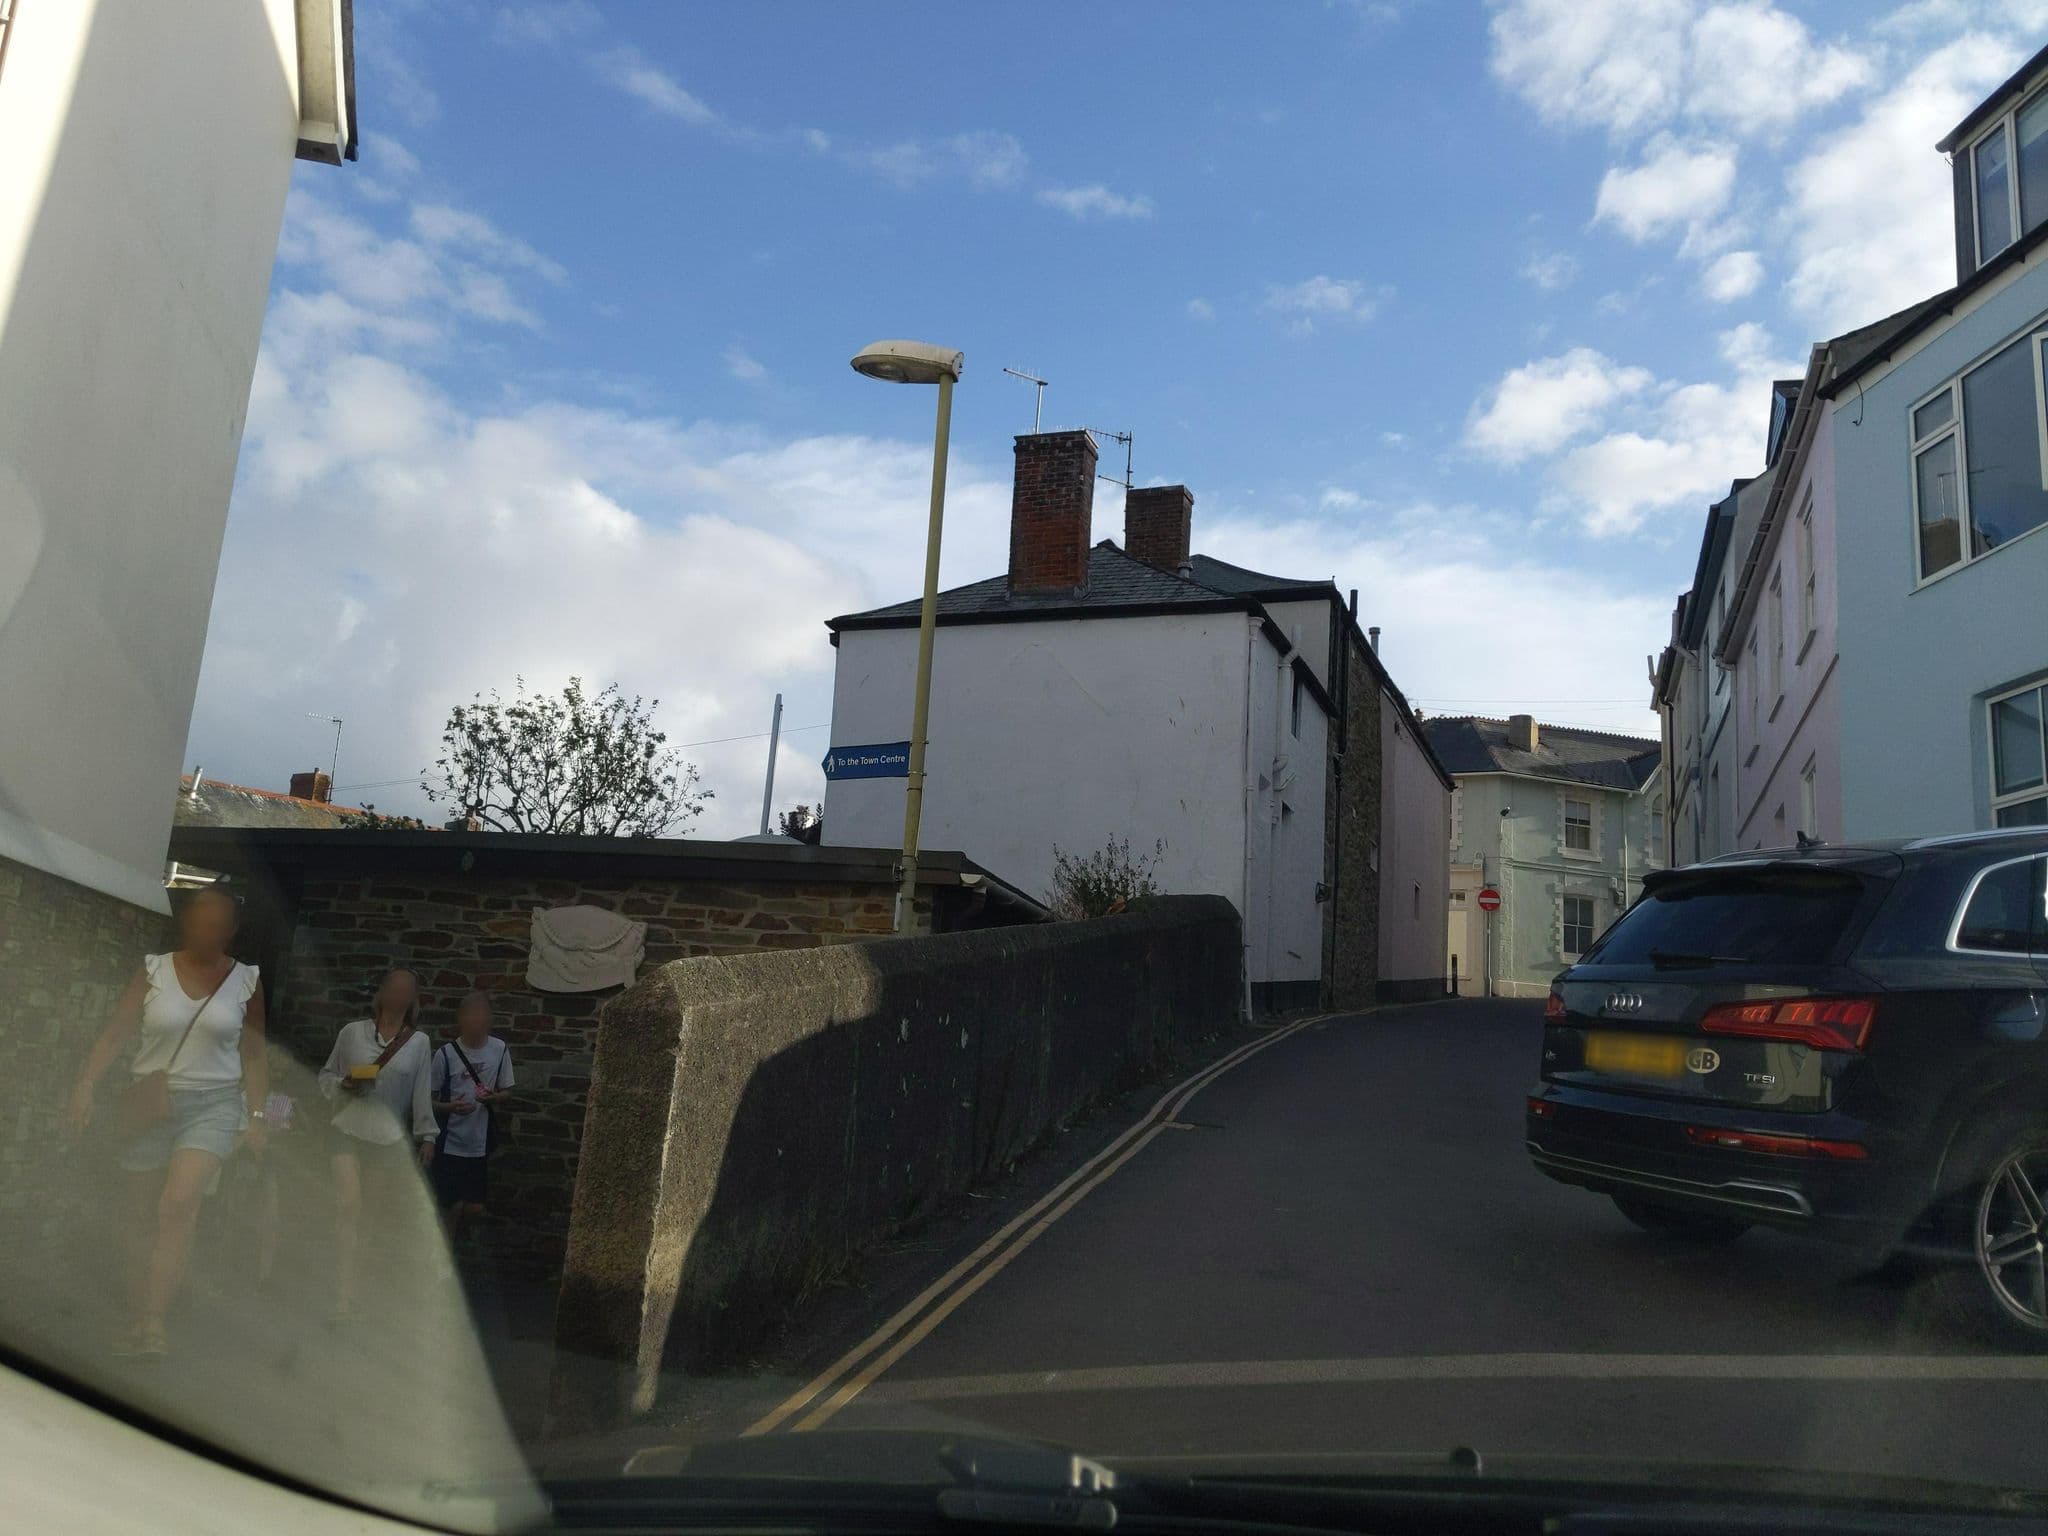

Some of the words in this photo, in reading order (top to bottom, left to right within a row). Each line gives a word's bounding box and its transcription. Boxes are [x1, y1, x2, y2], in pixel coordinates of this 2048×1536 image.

[838, 758, 846, 766] To
[847, 757, 859, 766] the
[860, 756, 878, 765] Town
[880, 755, 906, 764] Centre
[1687, 1051, 1715, 1070] GB
